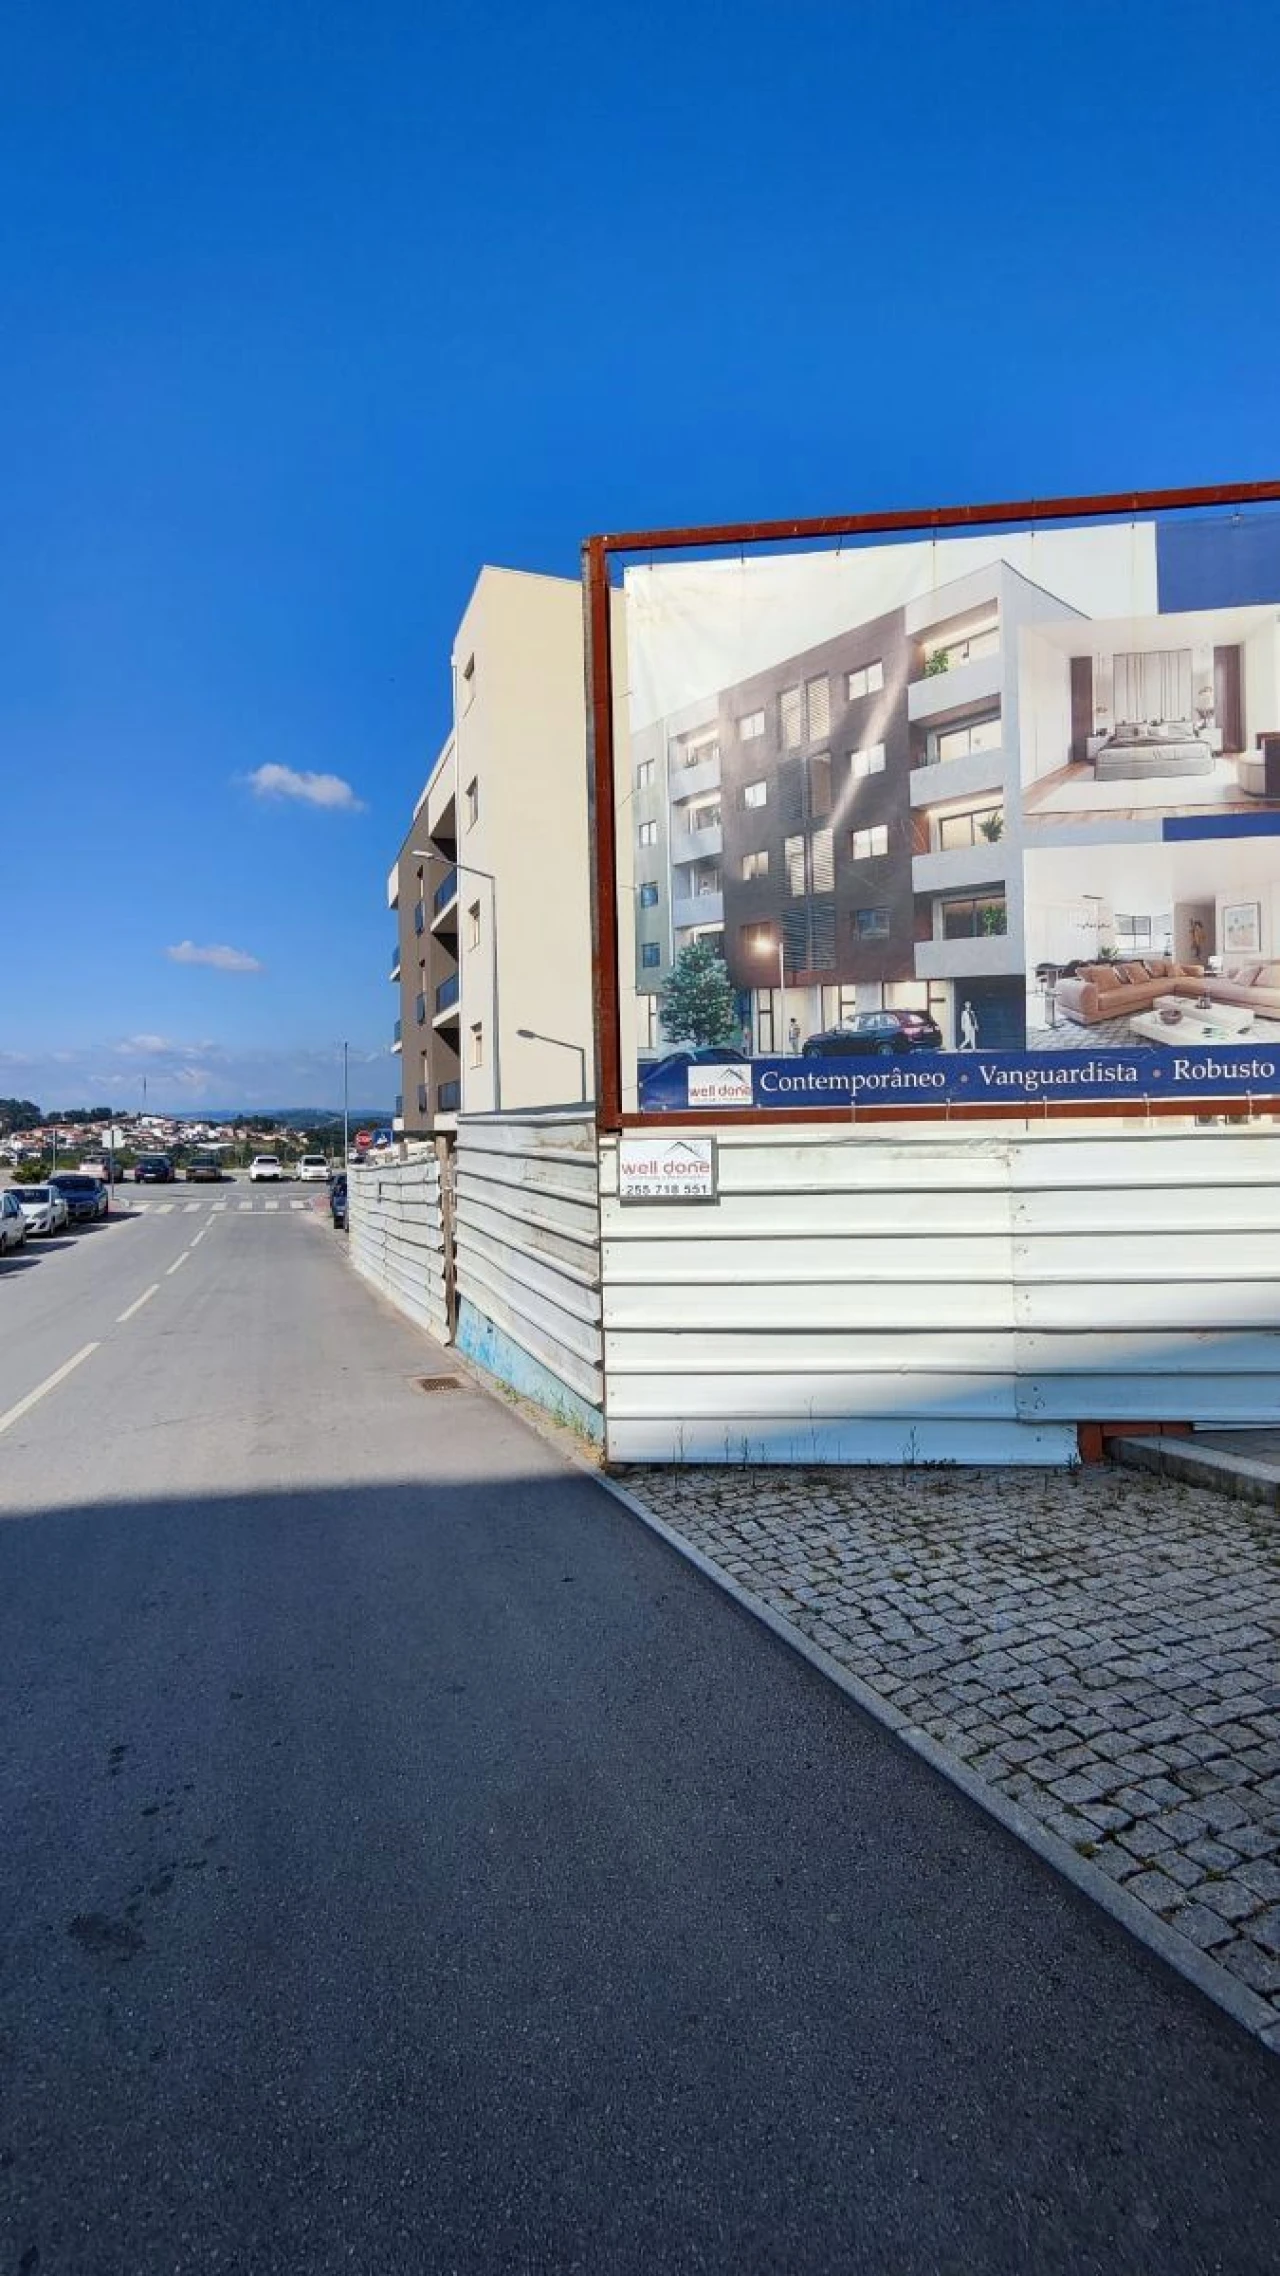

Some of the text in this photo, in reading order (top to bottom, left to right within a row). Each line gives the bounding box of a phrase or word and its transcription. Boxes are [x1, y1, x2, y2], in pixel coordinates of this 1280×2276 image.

[760, 1057, 1275, 1097] Contemporâneo Vanguardista Robusto
[621, 1160, 710, 1174] well done
